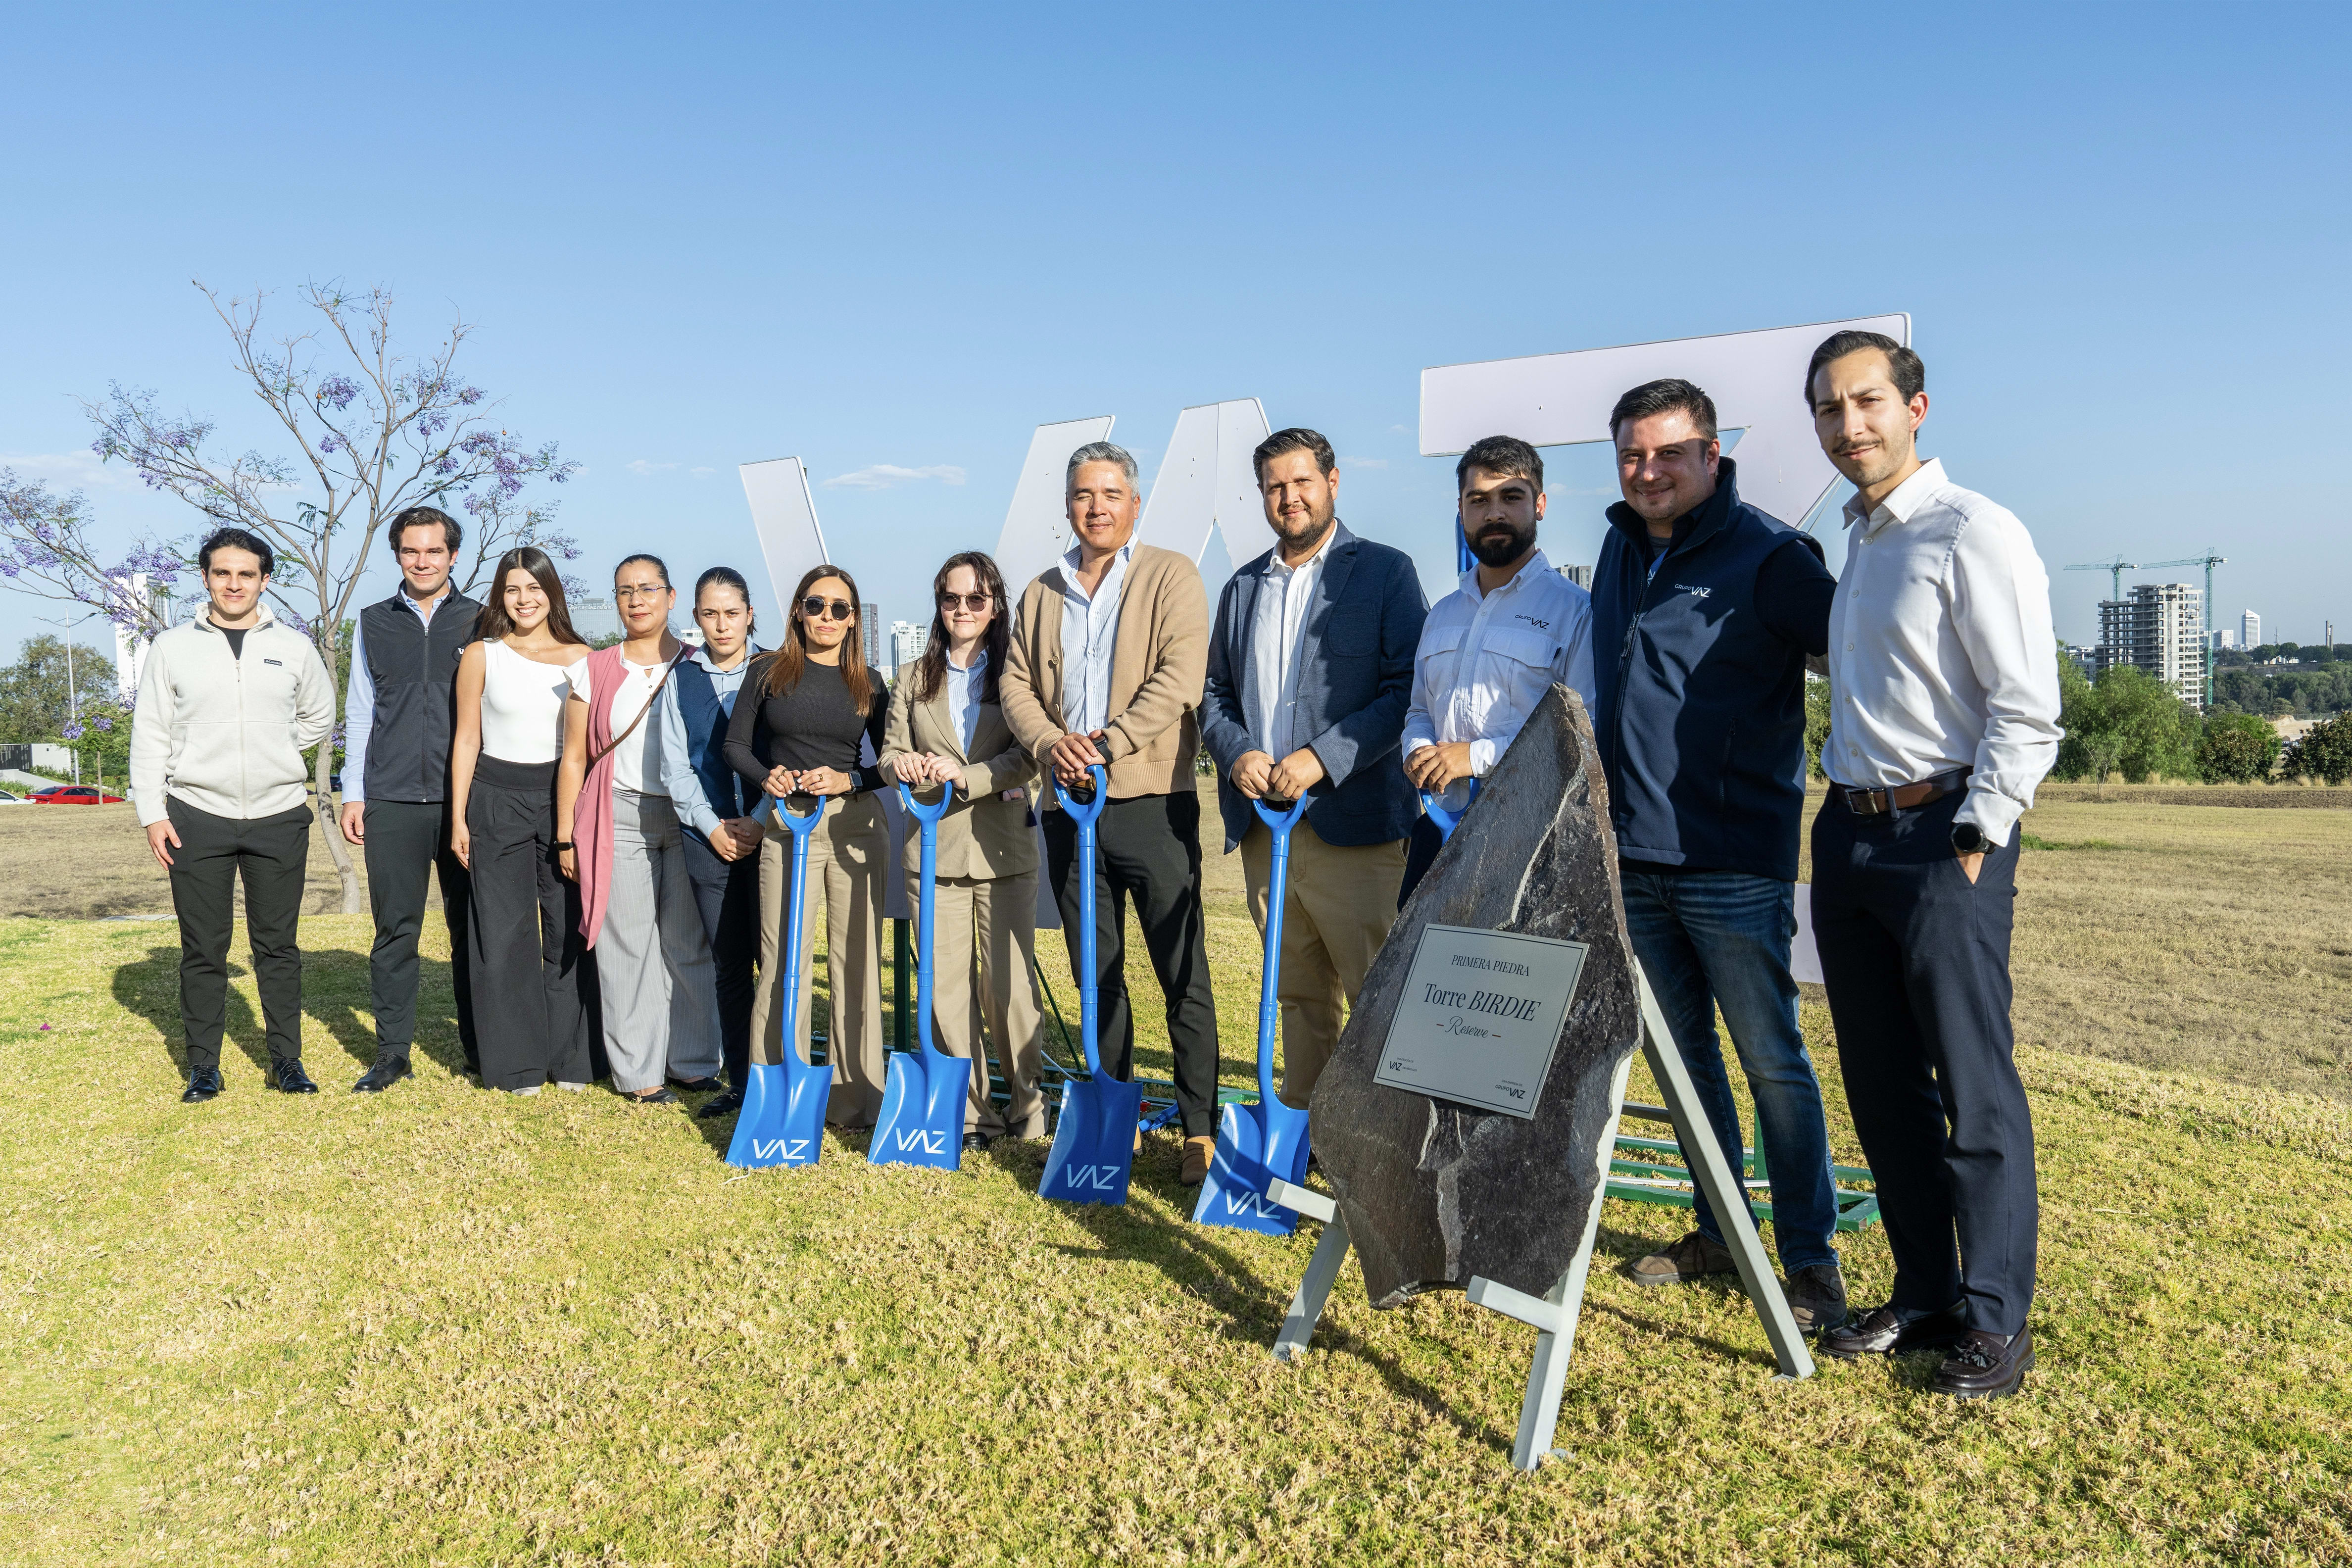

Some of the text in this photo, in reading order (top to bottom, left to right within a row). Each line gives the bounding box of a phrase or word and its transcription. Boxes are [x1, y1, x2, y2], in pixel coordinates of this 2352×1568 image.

[1691, 586, 1711, 598] VAZ
[1531, 617, 1550, 630] VAZ
[1451, 955, 1529, 977] PRIMERA PIEDRA
[1423, 983, 1542, 1021] Torre BIRDIE
[1445, 1016, 1489, 1038] Reserve
[1390, 1061, 1402, 1071] VAZ
[1510, 1087, 1525, 1099] VAZ
[753, 1139, 810, 1159] VAZ
[896, 1127, 946, 1154] VAZ
[1067, 1164, 1121, 1190] VAZ
